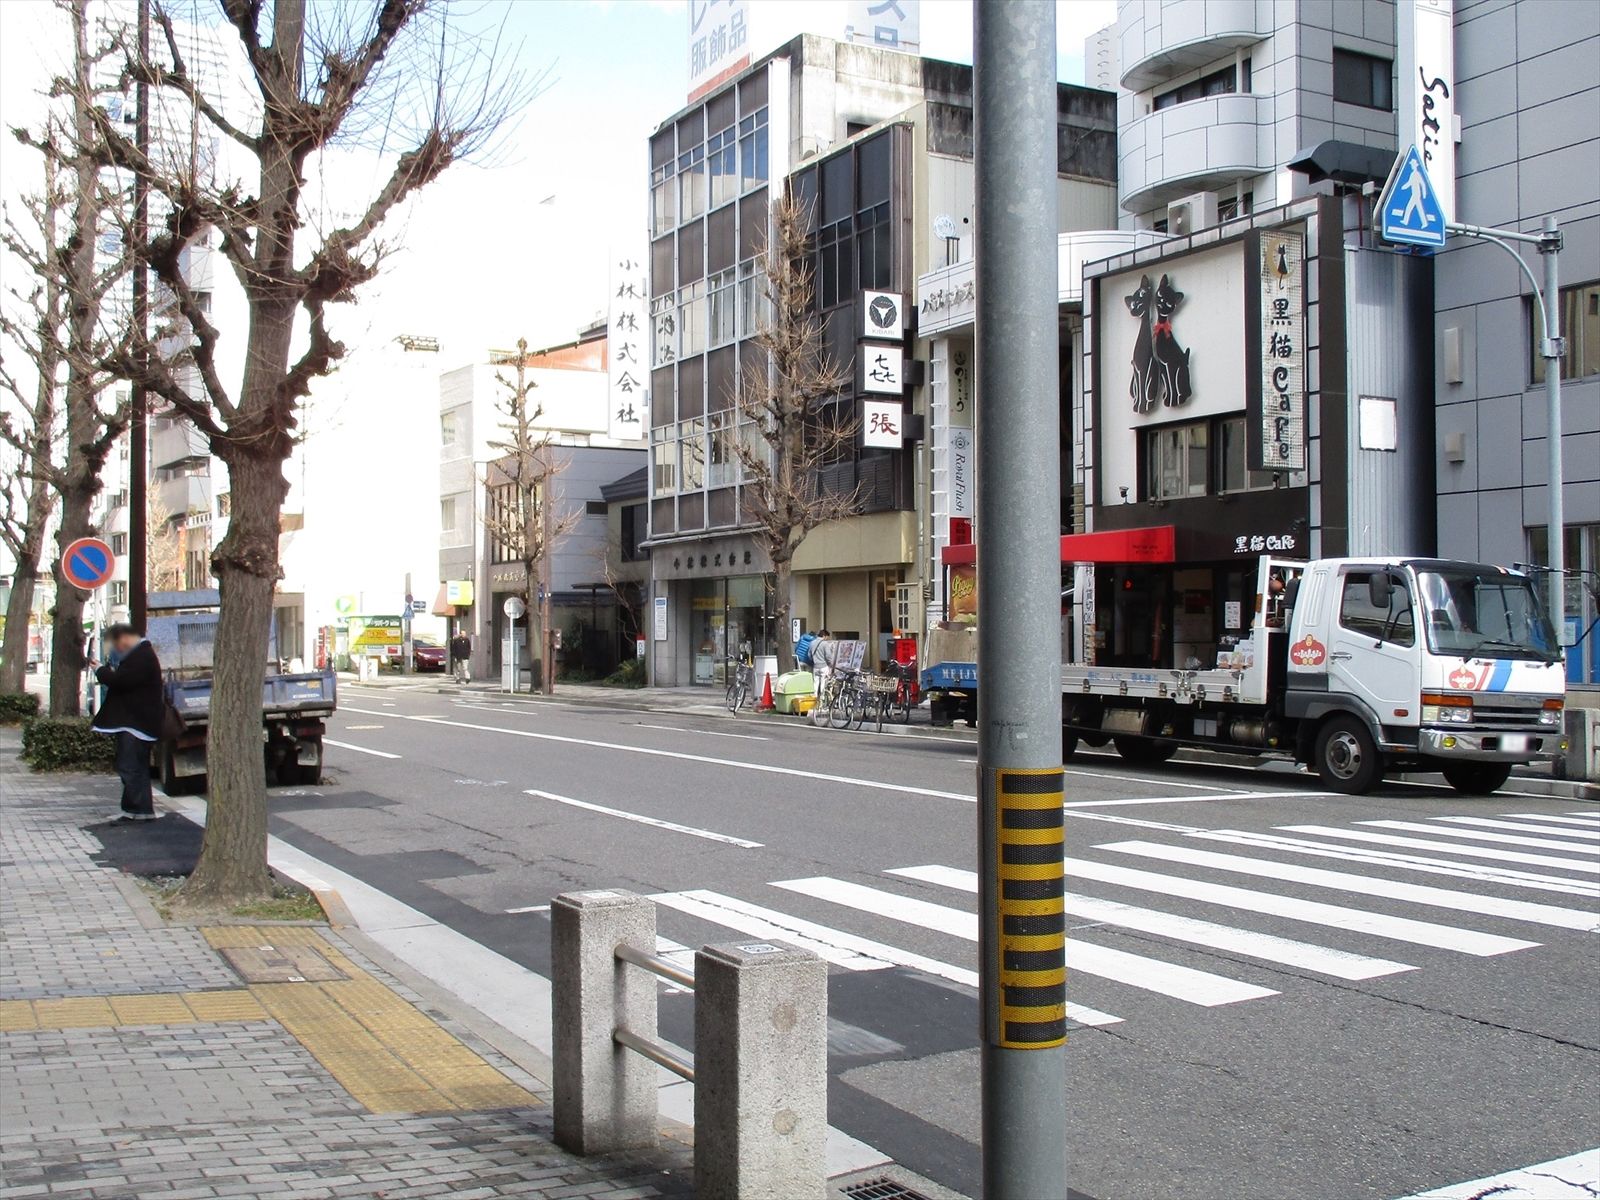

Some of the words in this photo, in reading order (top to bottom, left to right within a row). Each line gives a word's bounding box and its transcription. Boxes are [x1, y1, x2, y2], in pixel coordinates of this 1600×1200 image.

[691, 8, 747, 79] 服飾品
[616, 259, 642, 424] 小林株式会社
[870, 412, 899, 437] 張
